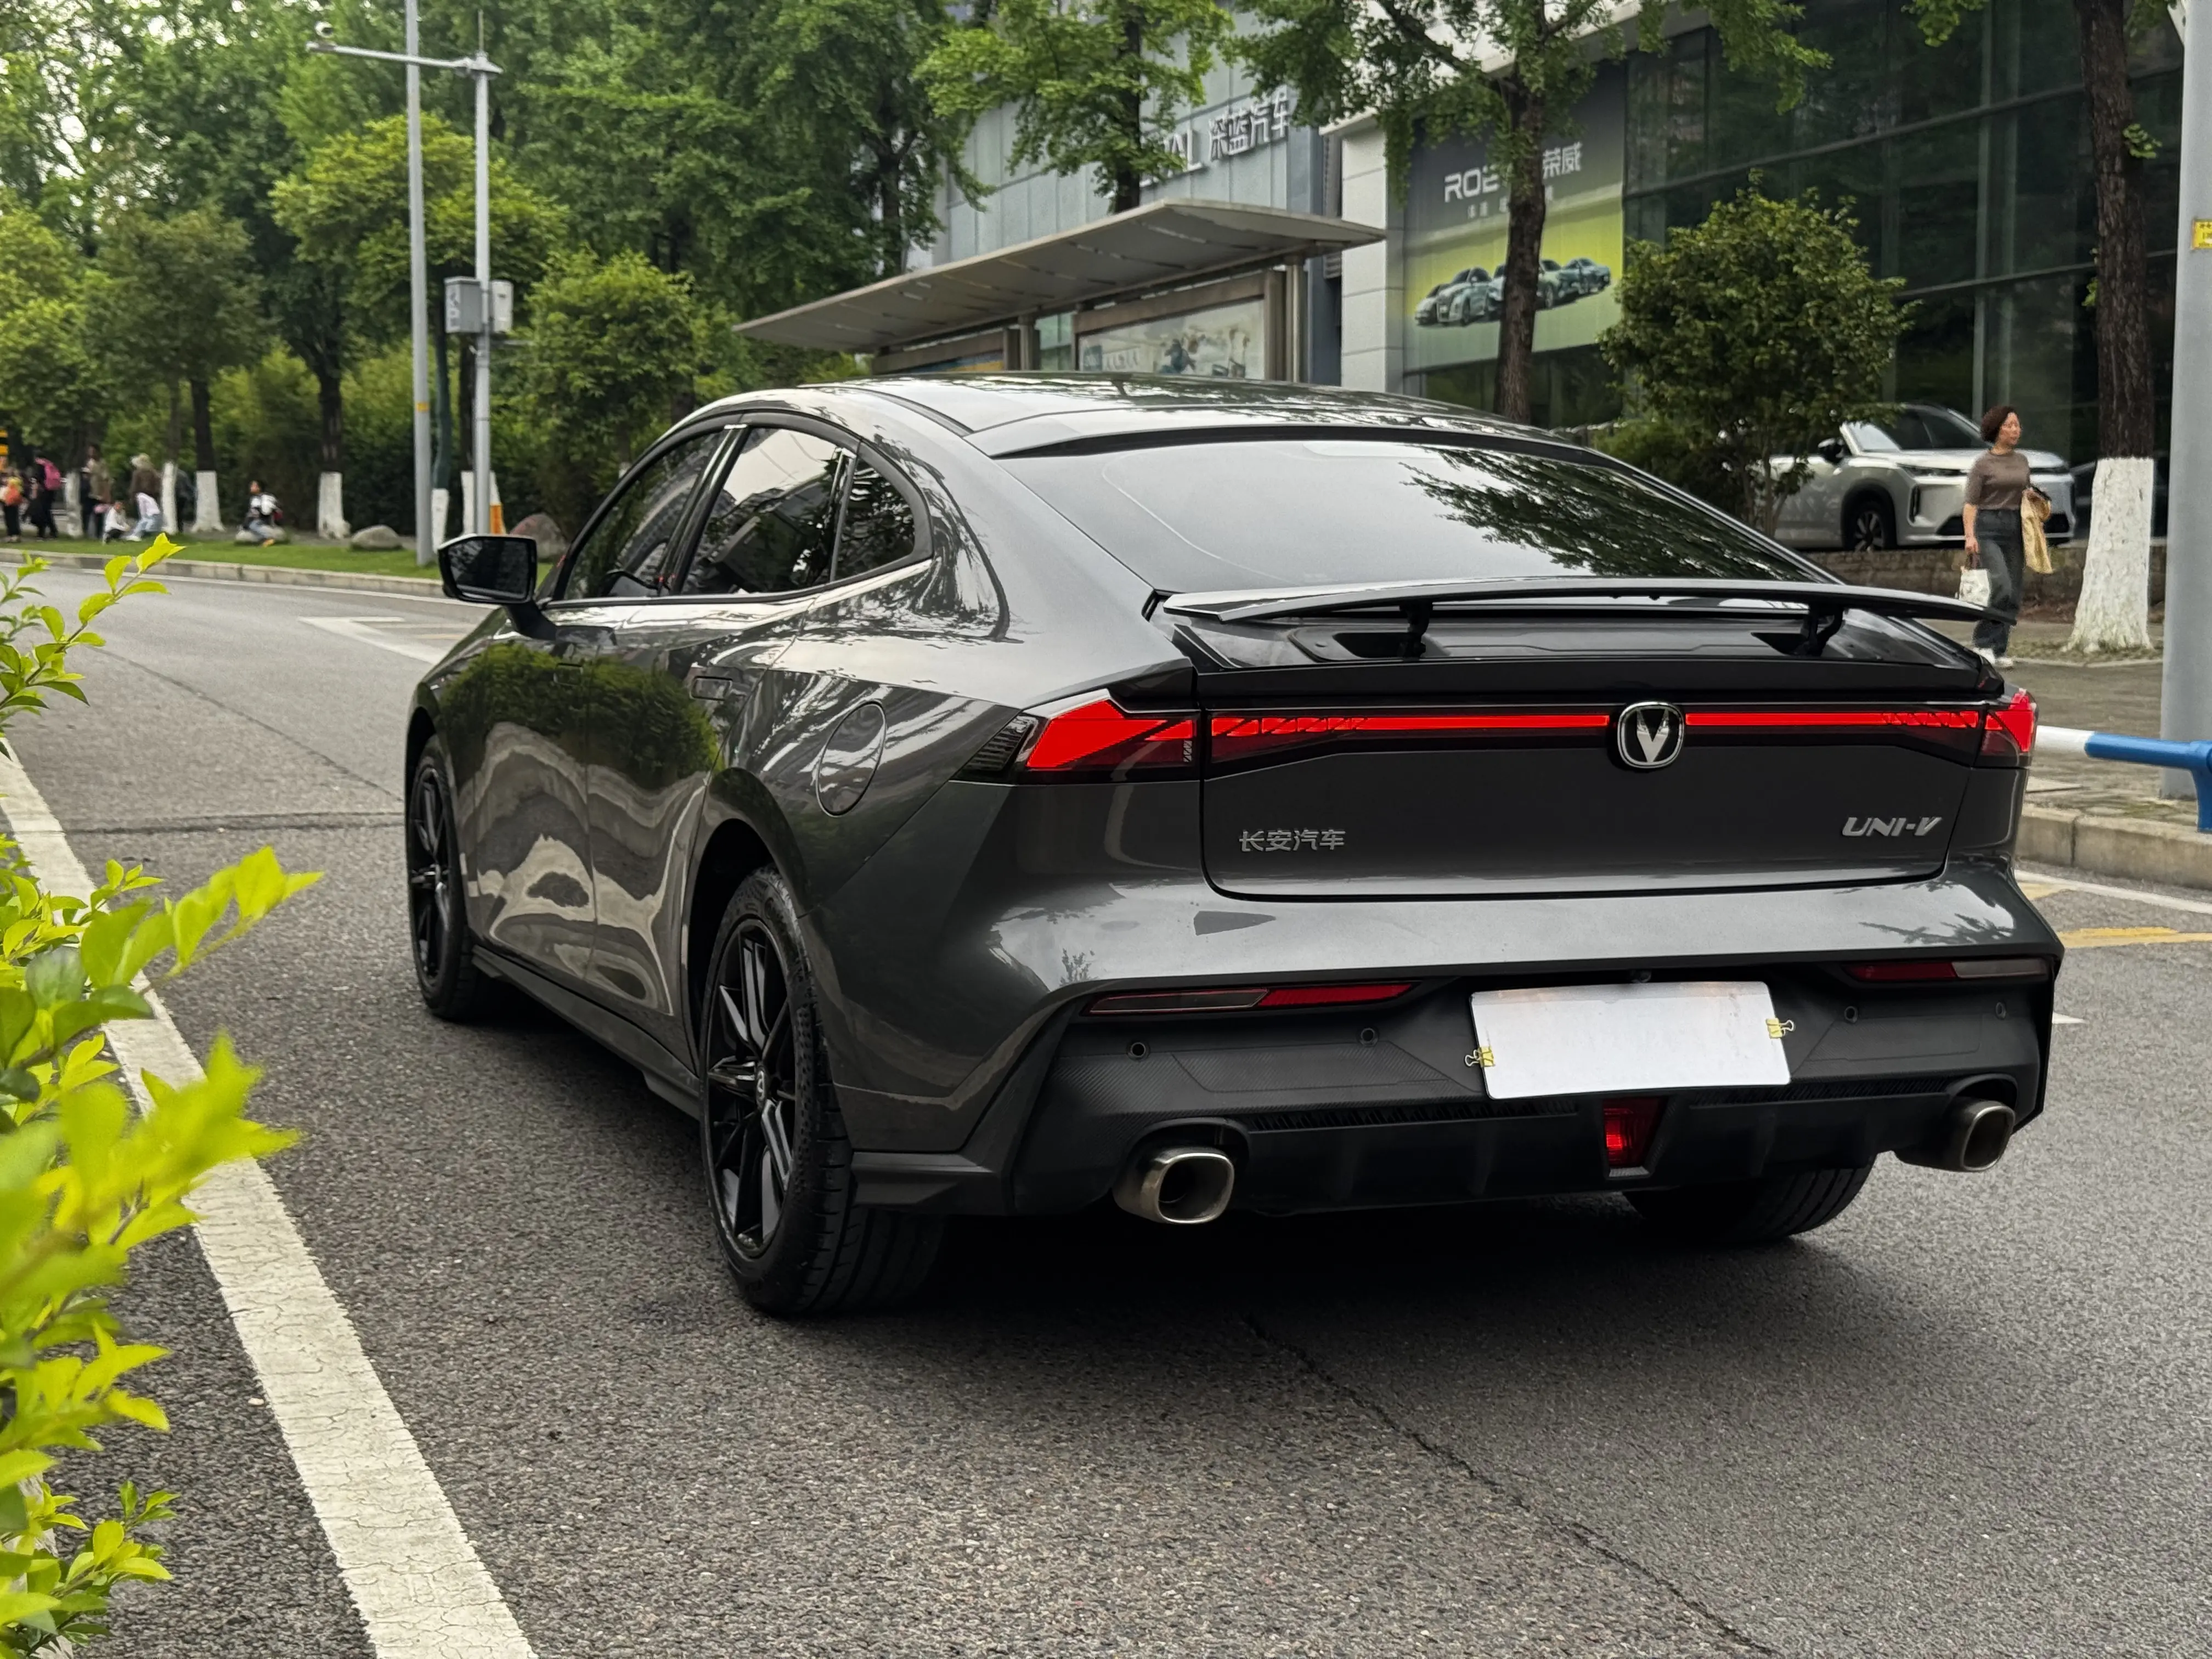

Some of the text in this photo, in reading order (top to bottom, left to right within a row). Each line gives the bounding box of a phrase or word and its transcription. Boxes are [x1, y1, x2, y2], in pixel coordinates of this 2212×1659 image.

[1208, 87, 1290, 162] 深蓝汽车
[1542, 141, 1583, 179] 荣威
[1239, 828, 1346, 852] 长安汽车
[1842, 816, 1942, 837] UNI-V
